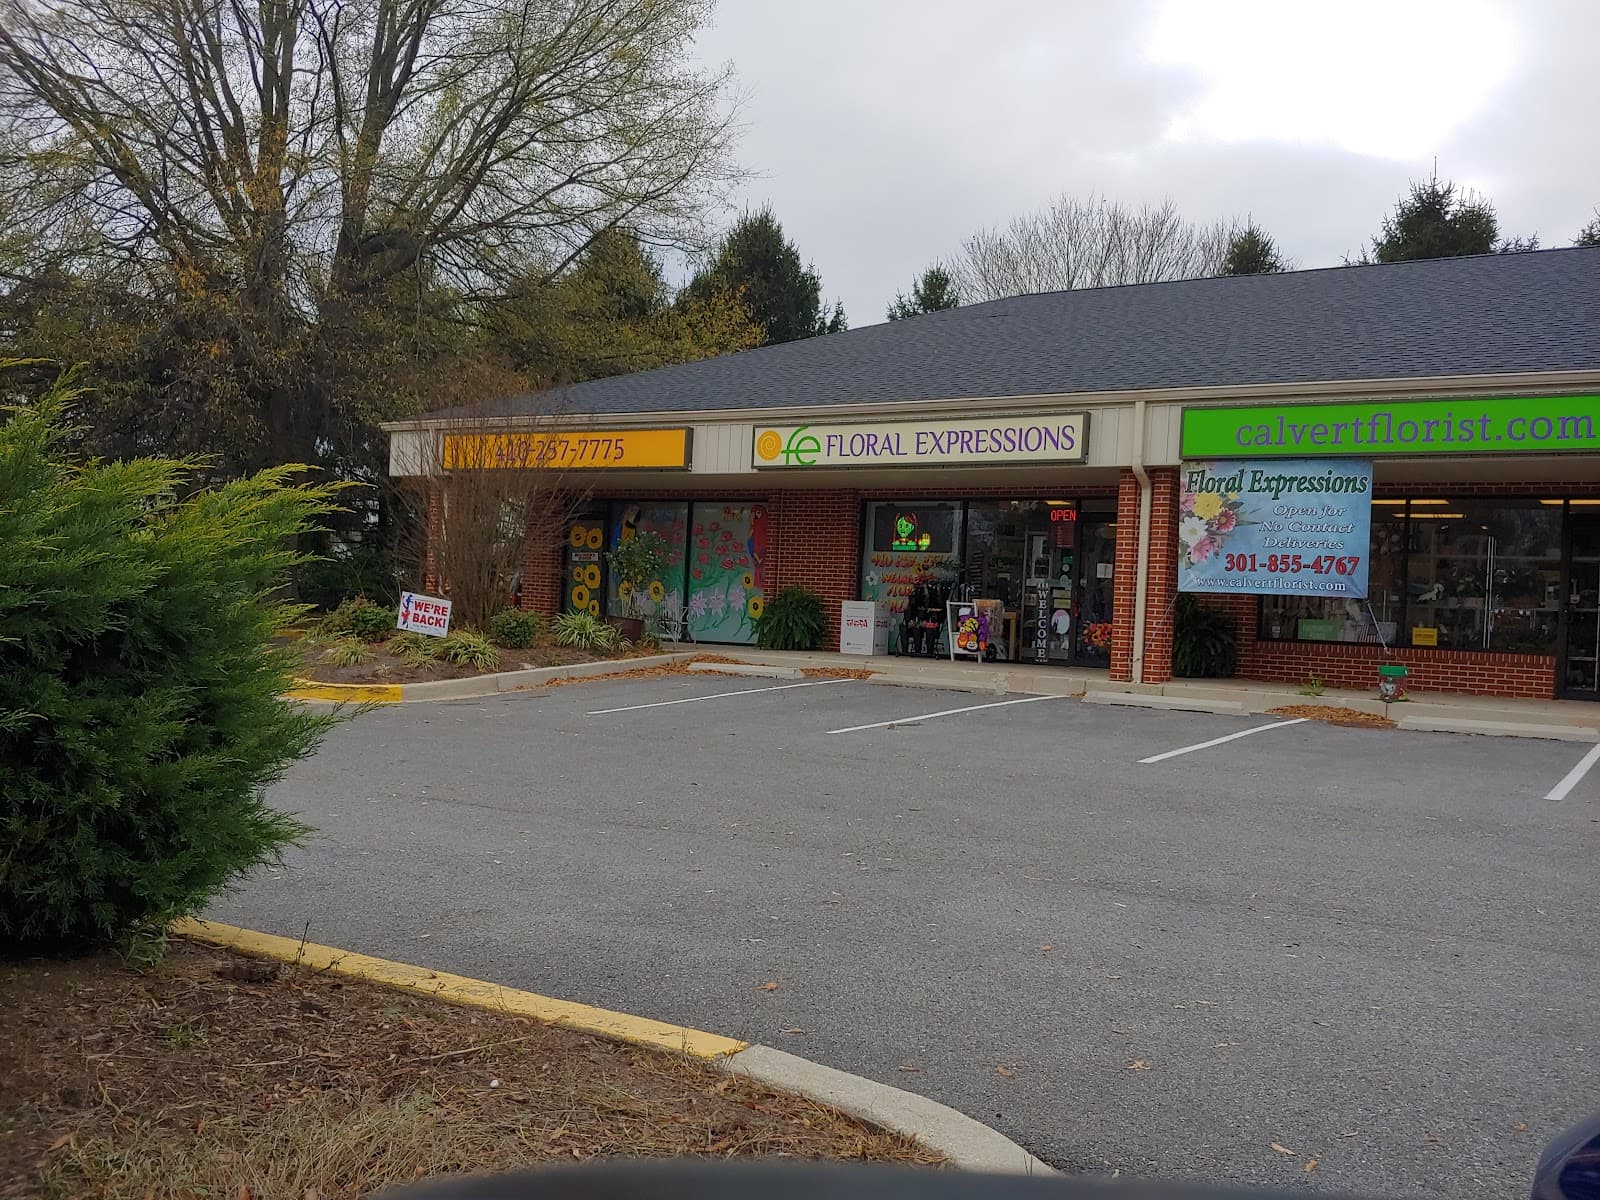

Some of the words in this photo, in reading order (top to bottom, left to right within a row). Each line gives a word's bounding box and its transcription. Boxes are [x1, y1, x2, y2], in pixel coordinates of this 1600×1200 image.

[1235, 411, 1596, 447] calvertflorist.com
[825, 432, 908, 457] FLORAL
[915, 424, 1075, 456] EXPRESSIONS
[1185, 468, 1245, 494] Floral
[1248, 469, 1369, 501] Expressions
[1050, 509, 1077, 522] OPEN
[1273, 505, 1317, 519] Open
[1318, 504, 1347, 519] for
[1259, 521, 1284, 533] No
[1288, 521, 1354, 534] Contact
[1263, 536, 1345, 550] Deliveries
[1224, 553, 1360, 576] 301-855-4767
[1193, 576, 1346, 592] www.calvertflorist.com
[414, 600, 449, 616] WE'RE
[412, 612, 447, 629] BACK!
[1036, 590, 1049, 659] WELCOME
